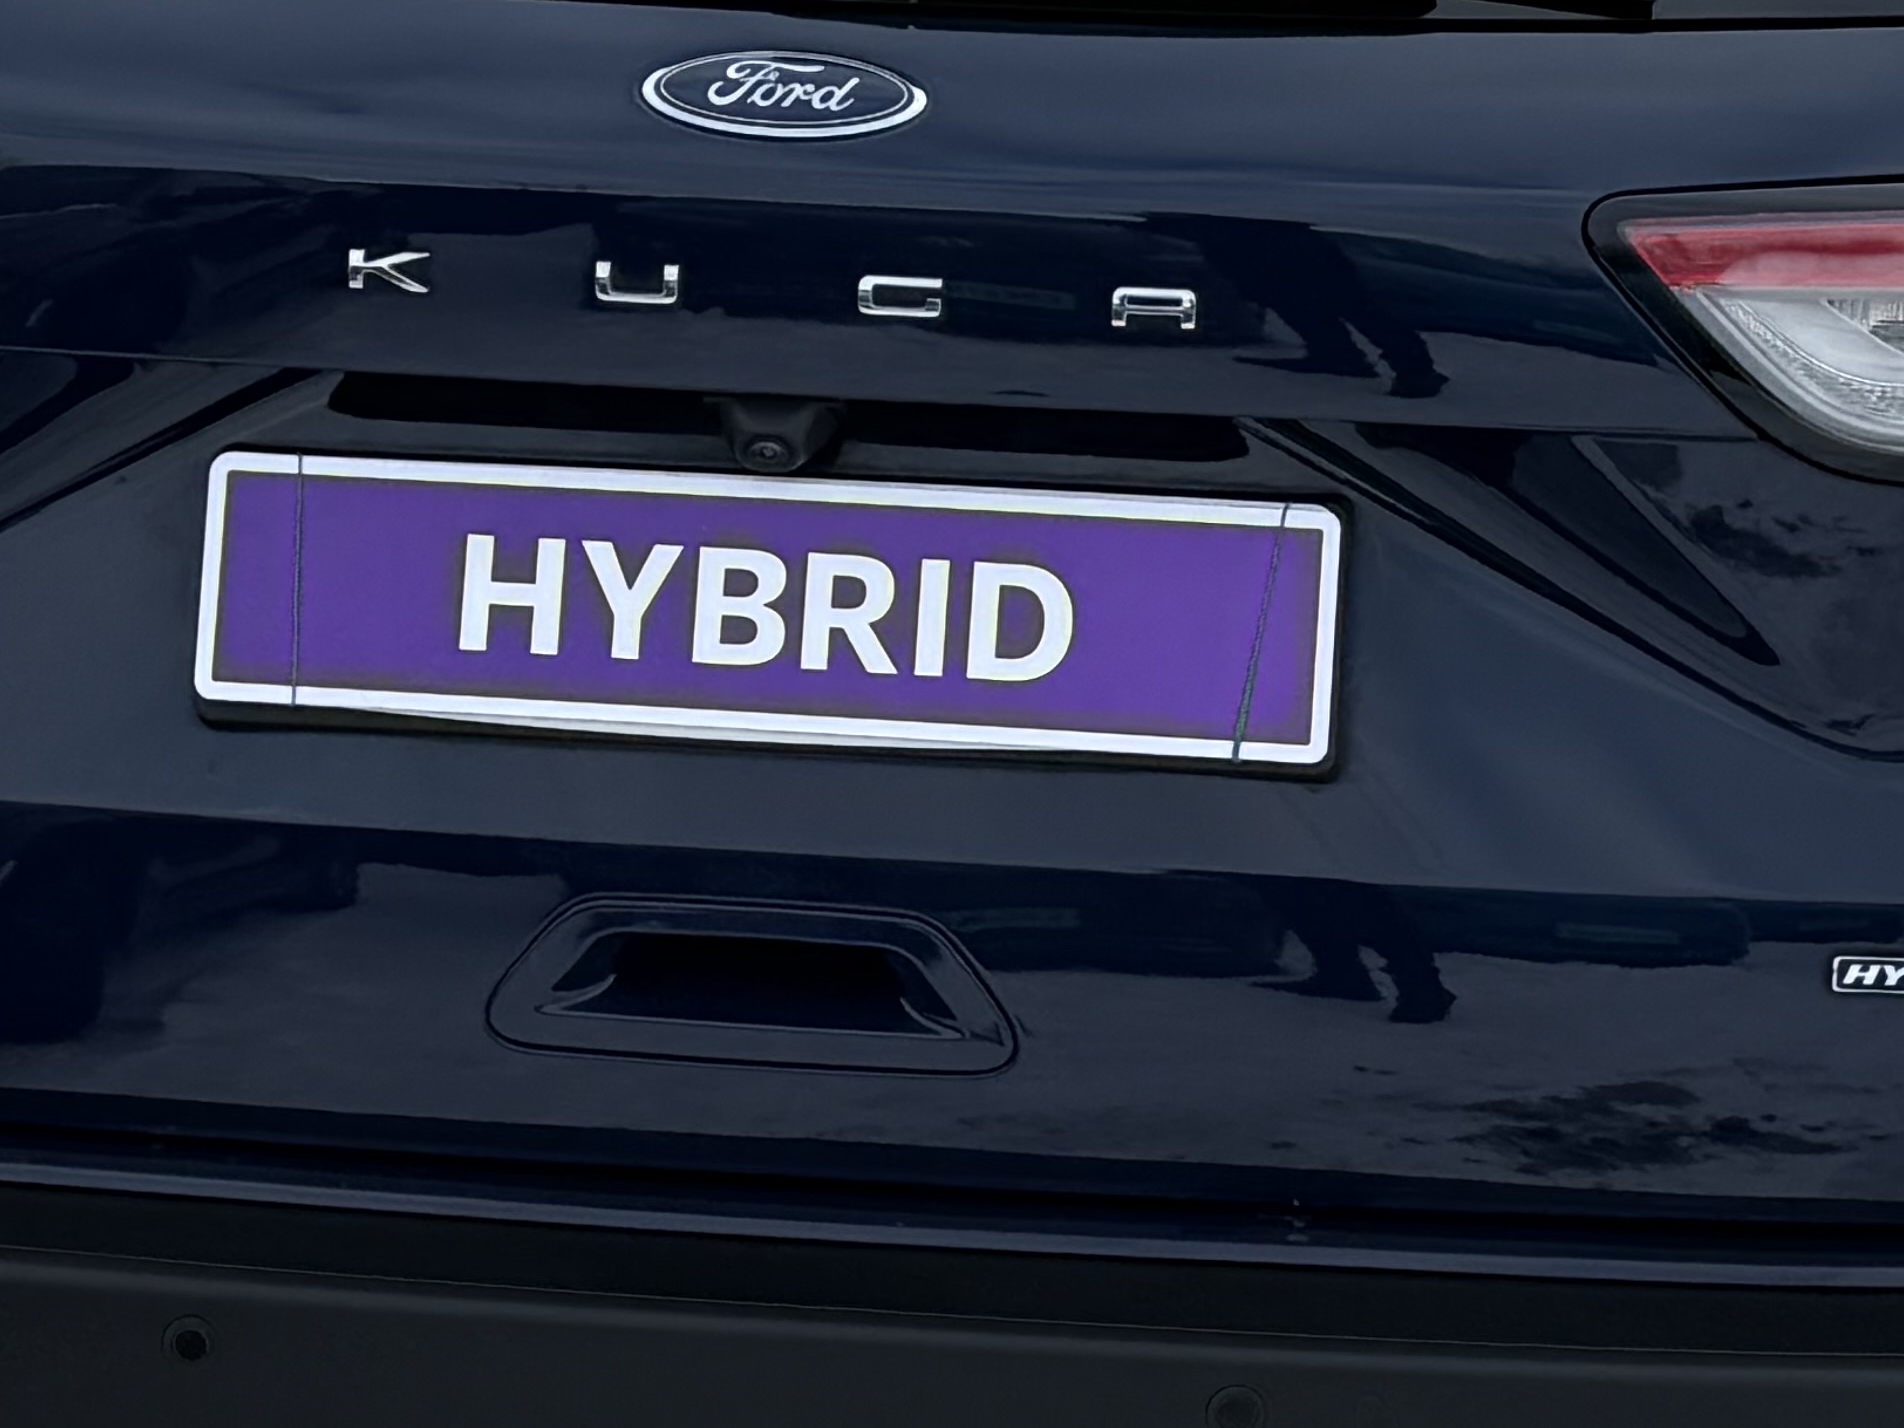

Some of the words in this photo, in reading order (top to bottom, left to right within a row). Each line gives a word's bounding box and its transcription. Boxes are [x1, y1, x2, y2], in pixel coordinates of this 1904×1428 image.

[707, 60, 860, 112] Ford
[347, 247, 1197, 330] KUGA
[457, 532, 1074, 684] HYBRID
